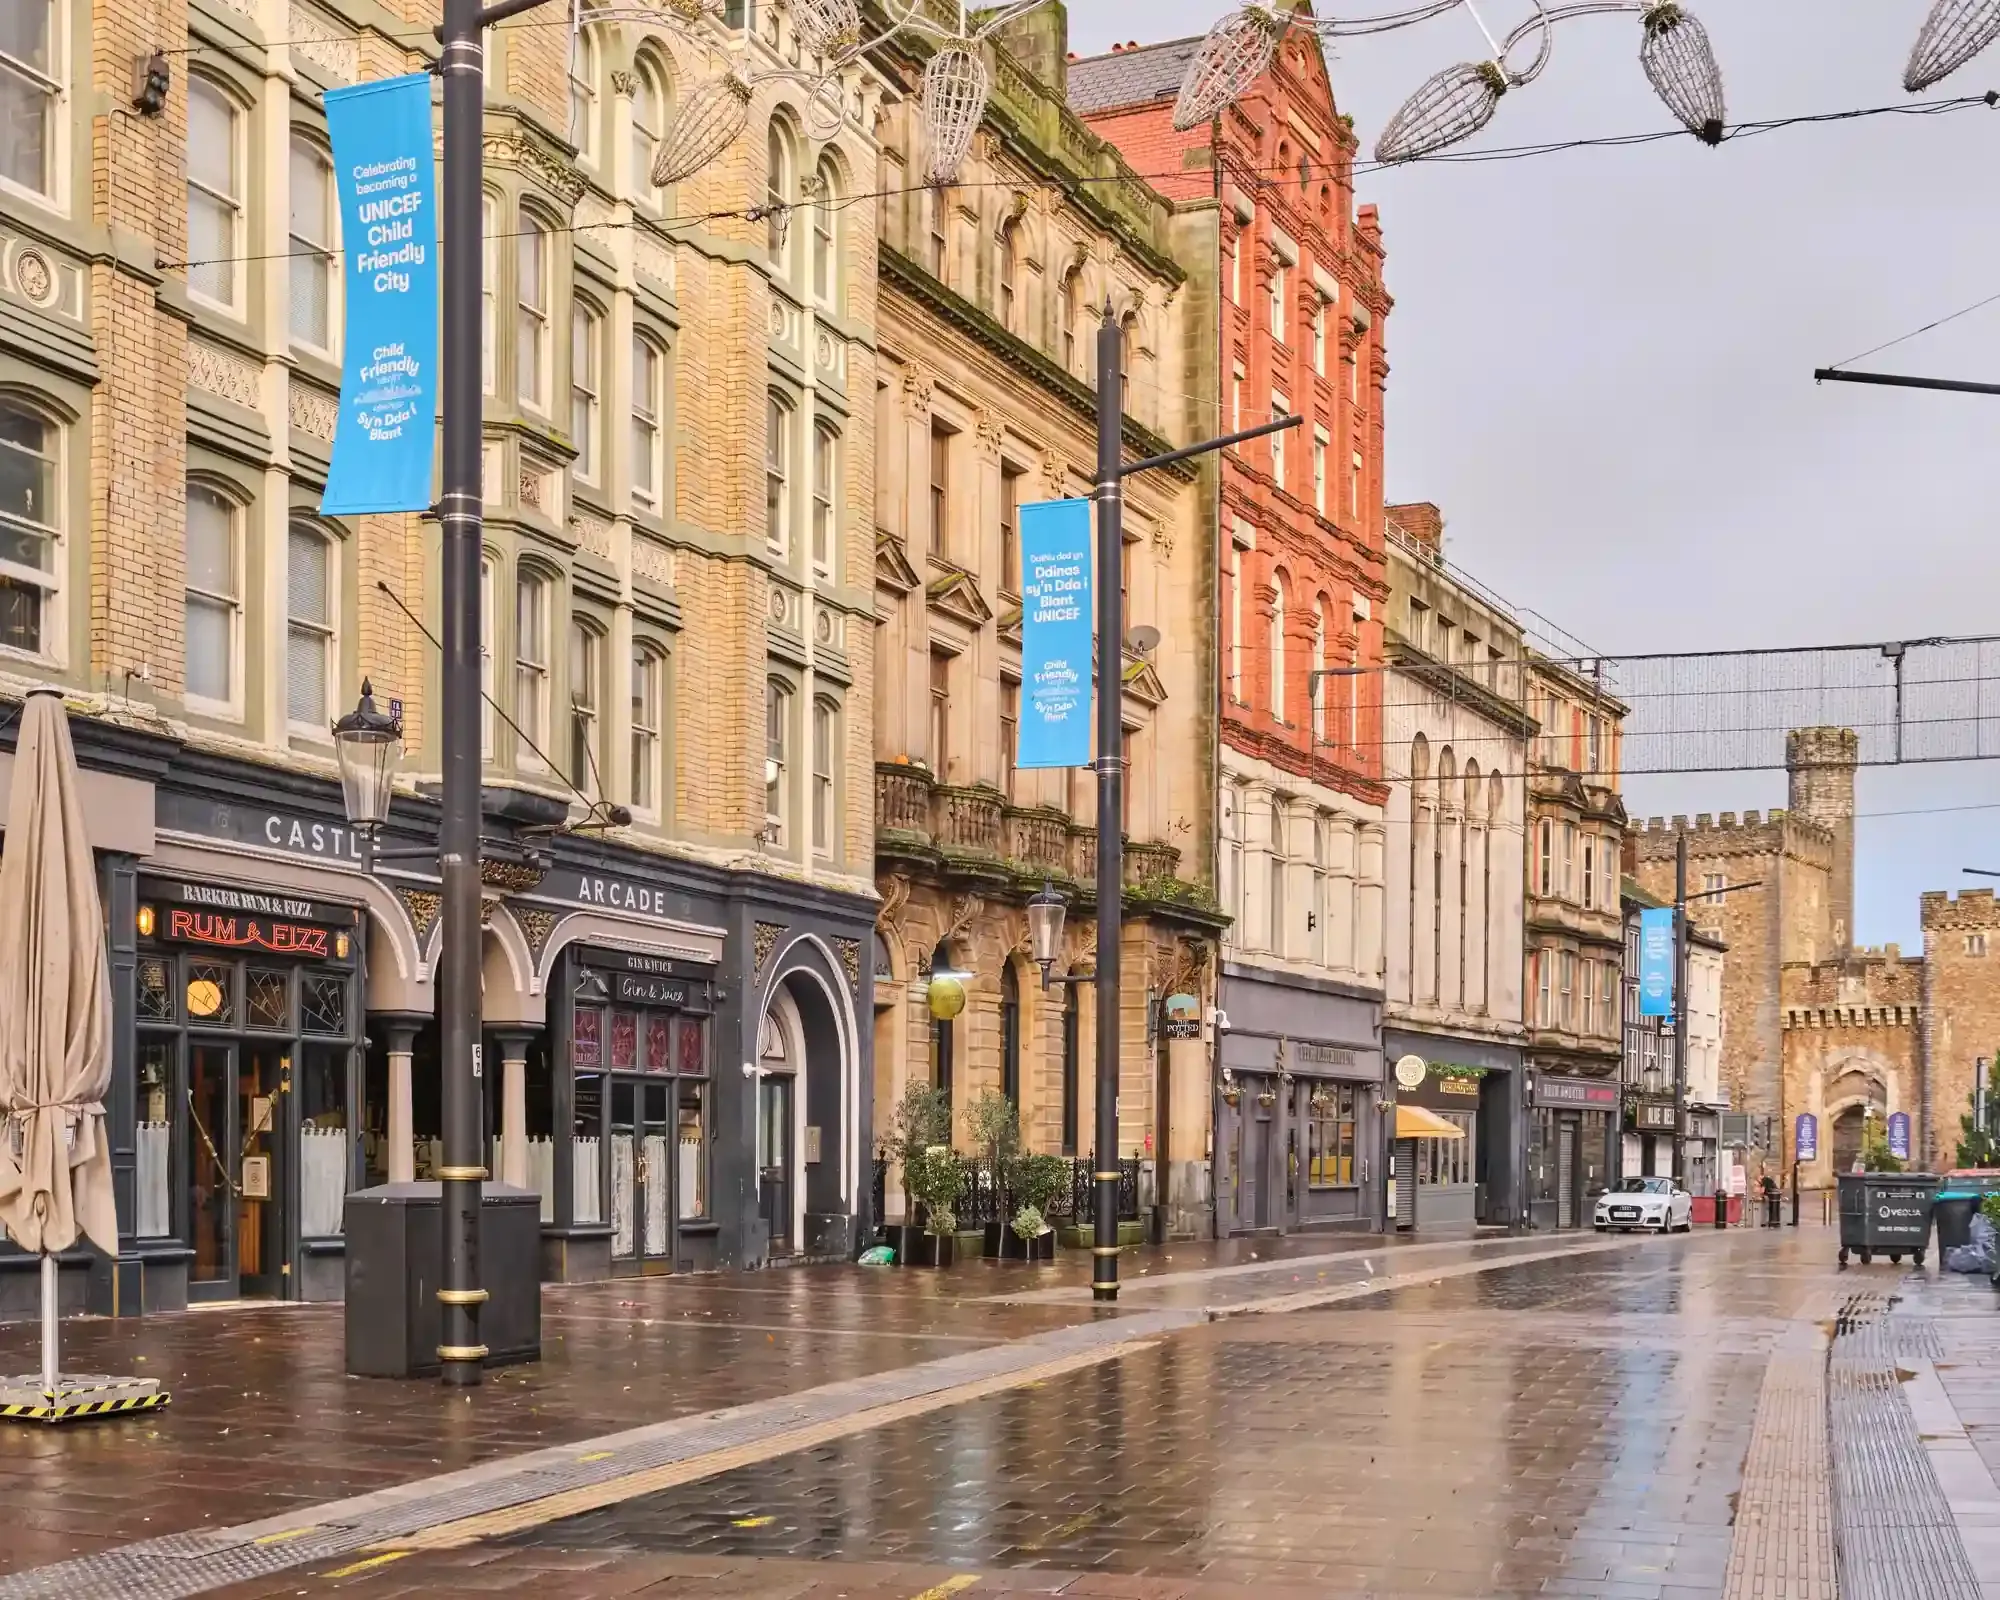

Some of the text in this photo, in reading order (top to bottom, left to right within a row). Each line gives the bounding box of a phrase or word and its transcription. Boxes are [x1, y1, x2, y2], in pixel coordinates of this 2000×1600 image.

[353, 157, 416, 179] Celebrating
[355, 174, 417, 195] becoming a
[359, 192, 422, 223] UNICEF
[368, 218, 412, 246] Child
[357, 242, 425, 273] Friendly
[374, 271, 410, 292] City
[373, 343, 405, 360] Child
[360, 356, 420, 383] Friendly
[369, 426, 402, 441] Blant
[1040, 594, 1074, 608] Blant
[1033, 607, 1081, 622] UNICEF
[182, 885, 313, 917] BARKER RUM & FIZZ
[579, 877, 664, 914] ARCADE
[171, 910, 328, 956] RUM & FIZZ
[628, 957, 673, 973] GIN & JUICE
[622, 978, 684, 1002] Gin & Juice
[1167, 1024, 1199, 1032] POTTED
